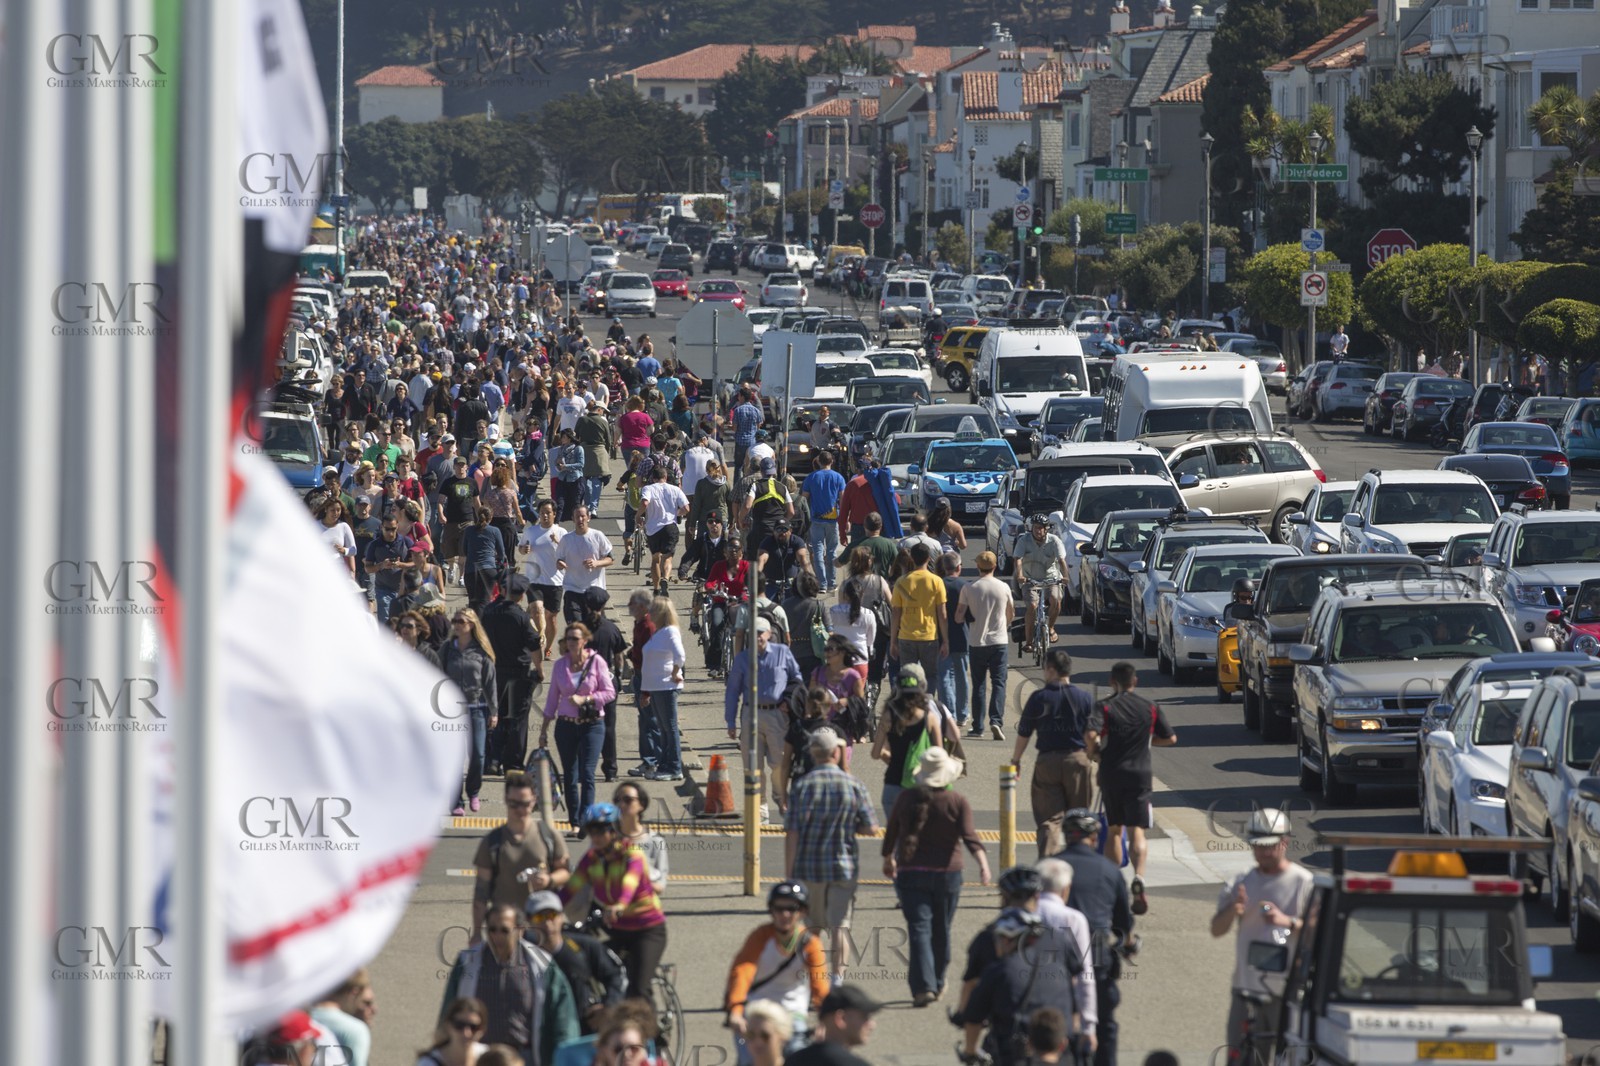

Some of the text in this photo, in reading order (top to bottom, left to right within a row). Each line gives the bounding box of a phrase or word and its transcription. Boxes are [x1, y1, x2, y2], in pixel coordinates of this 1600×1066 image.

[1106, 170, 1137, 179] Scott
[1287, 168, 1343, 177] Divisadero
[861, 211, 883, 221] STOP
